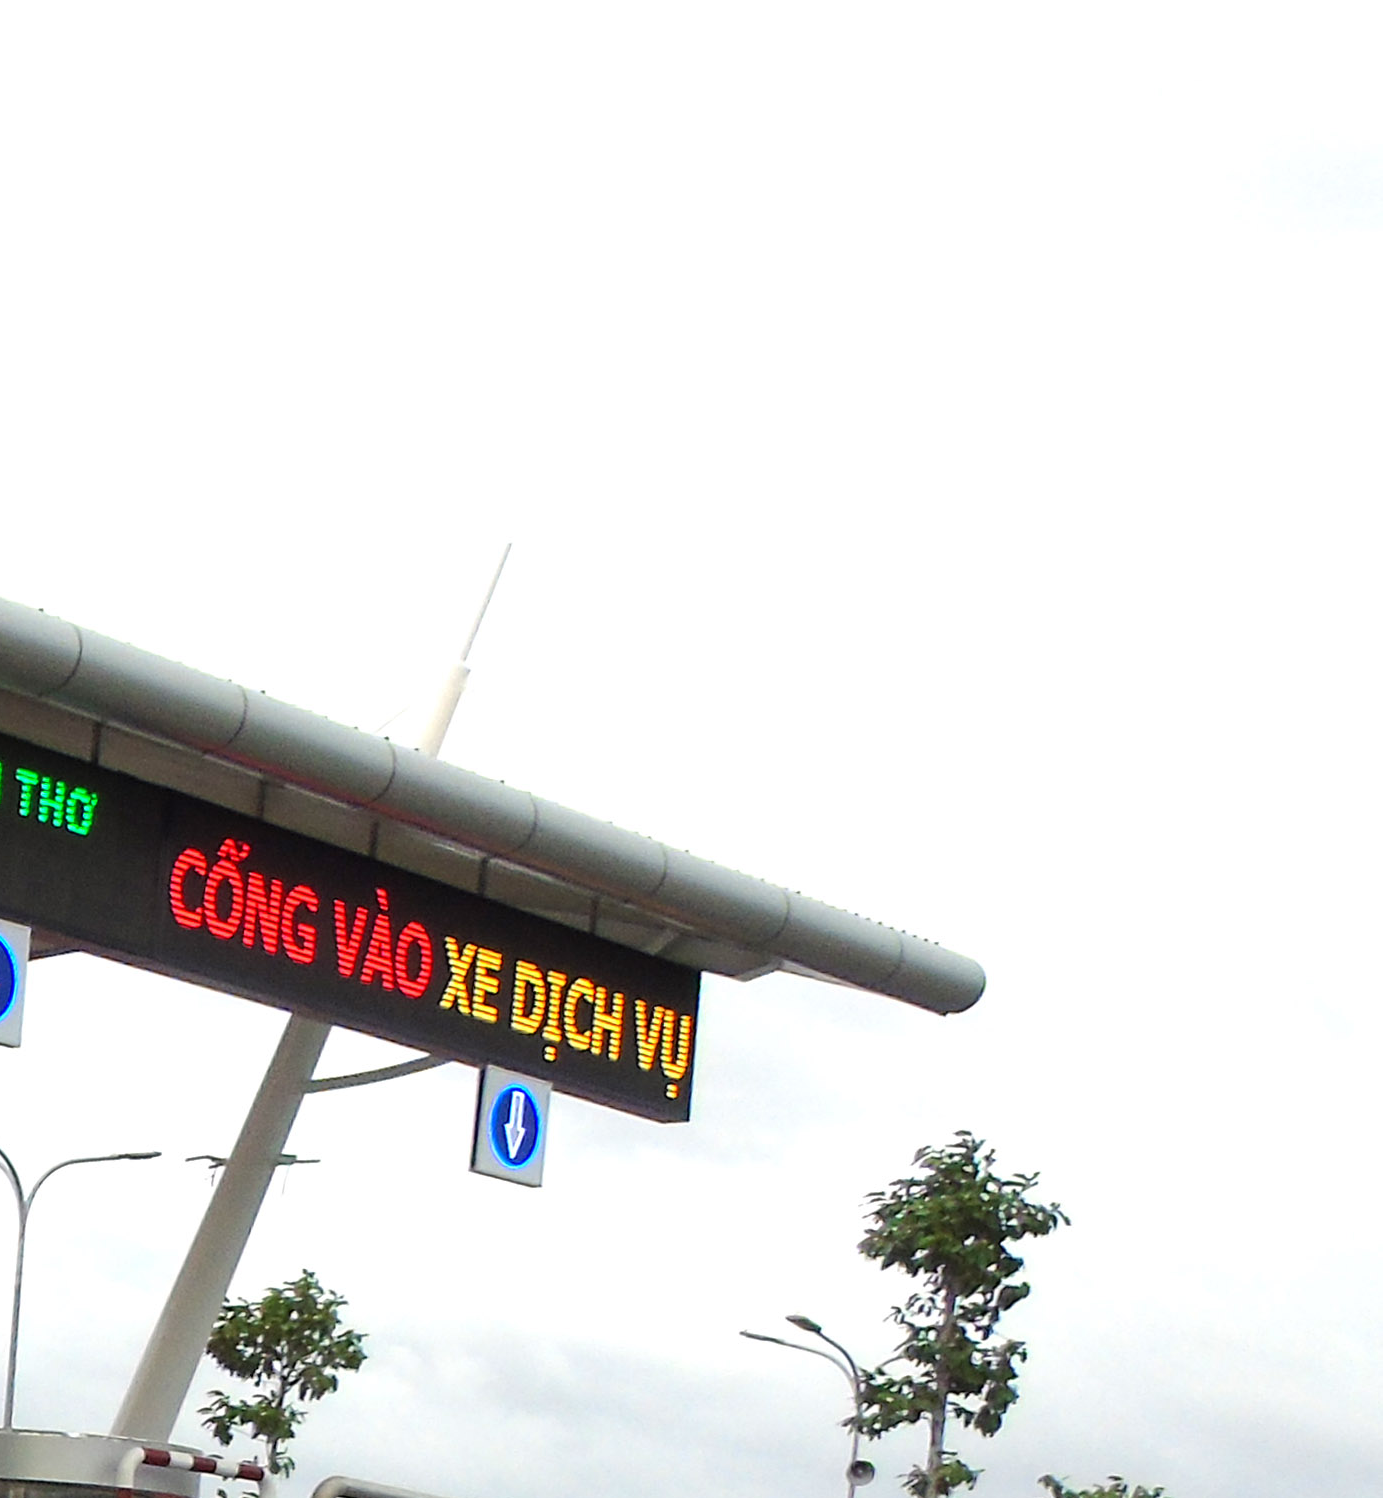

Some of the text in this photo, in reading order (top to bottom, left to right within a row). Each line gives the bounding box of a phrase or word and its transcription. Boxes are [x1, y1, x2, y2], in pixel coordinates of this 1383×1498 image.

[15, 765, 99, 836] THƠ
[169, 838, 693, 1099] CỔNG VÀO XE DỊCH VỤ
